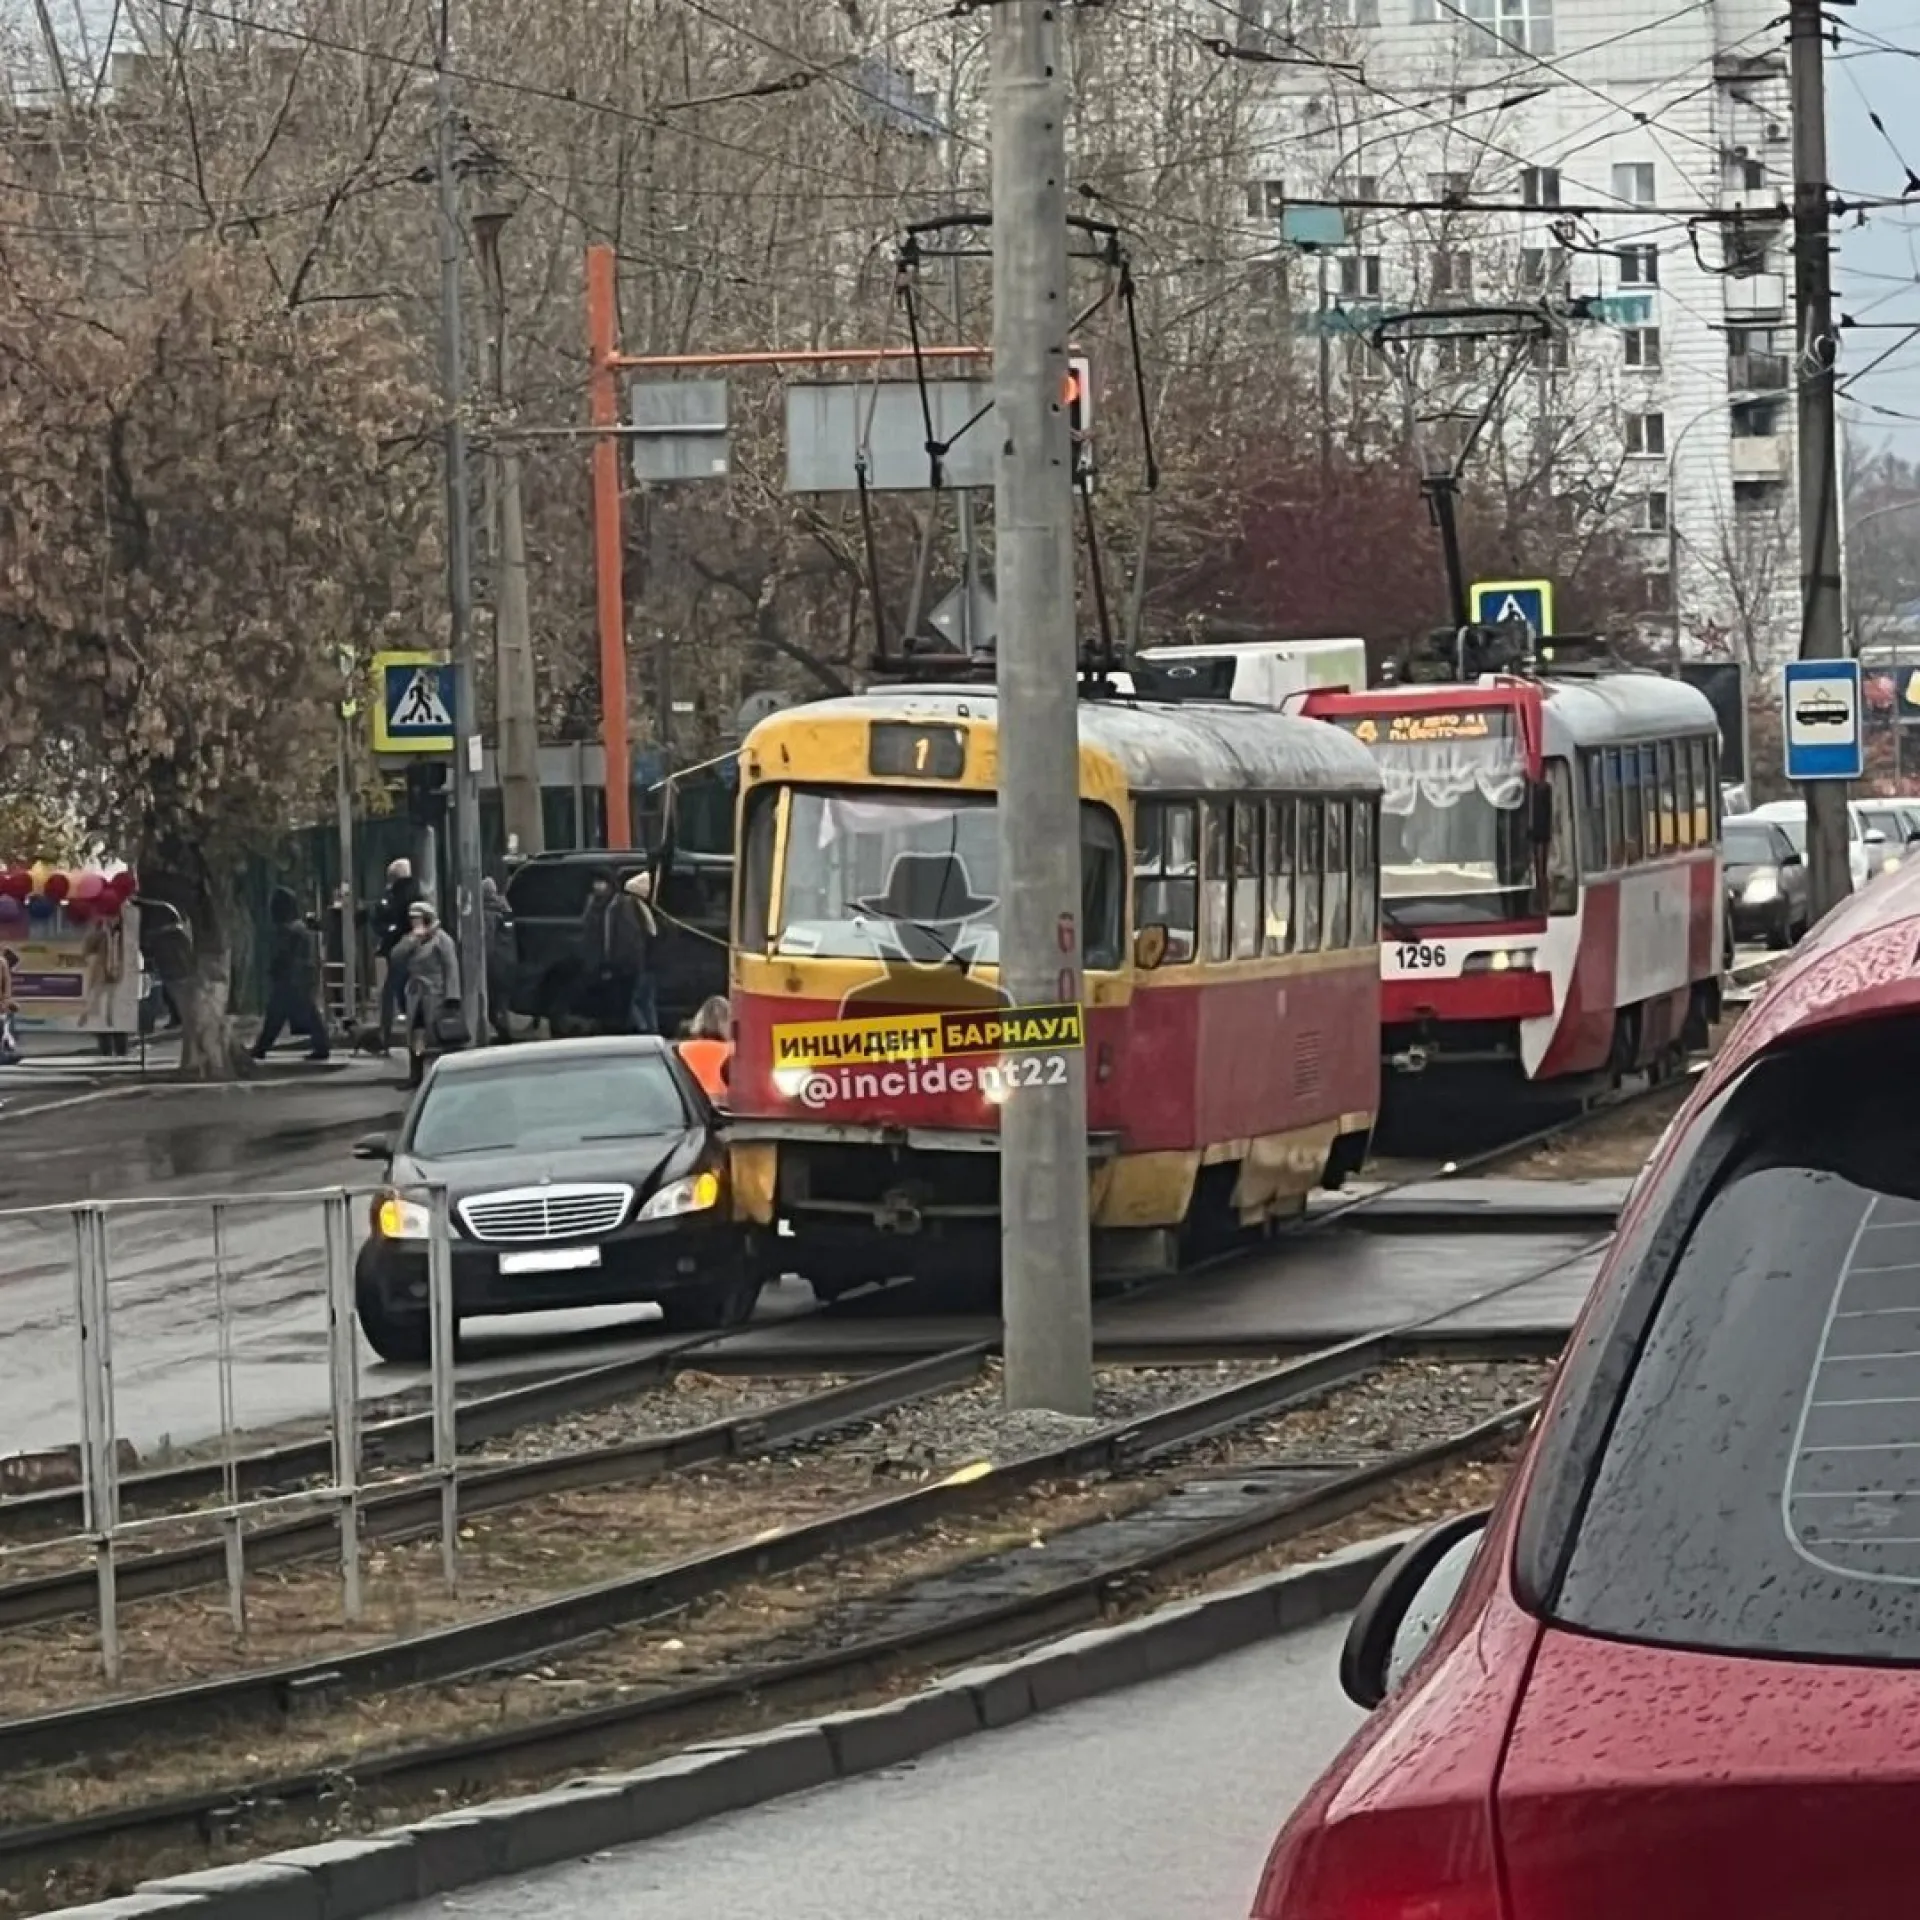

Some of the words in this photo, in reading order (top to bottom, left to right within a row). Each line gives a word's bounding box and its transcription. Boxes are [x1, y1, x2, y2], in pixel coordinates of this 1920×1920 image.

[1357, 720, 1378, 742] 4
[915, 737, 929, 771] 1
[1395, 944, 1446, 970] 1296
